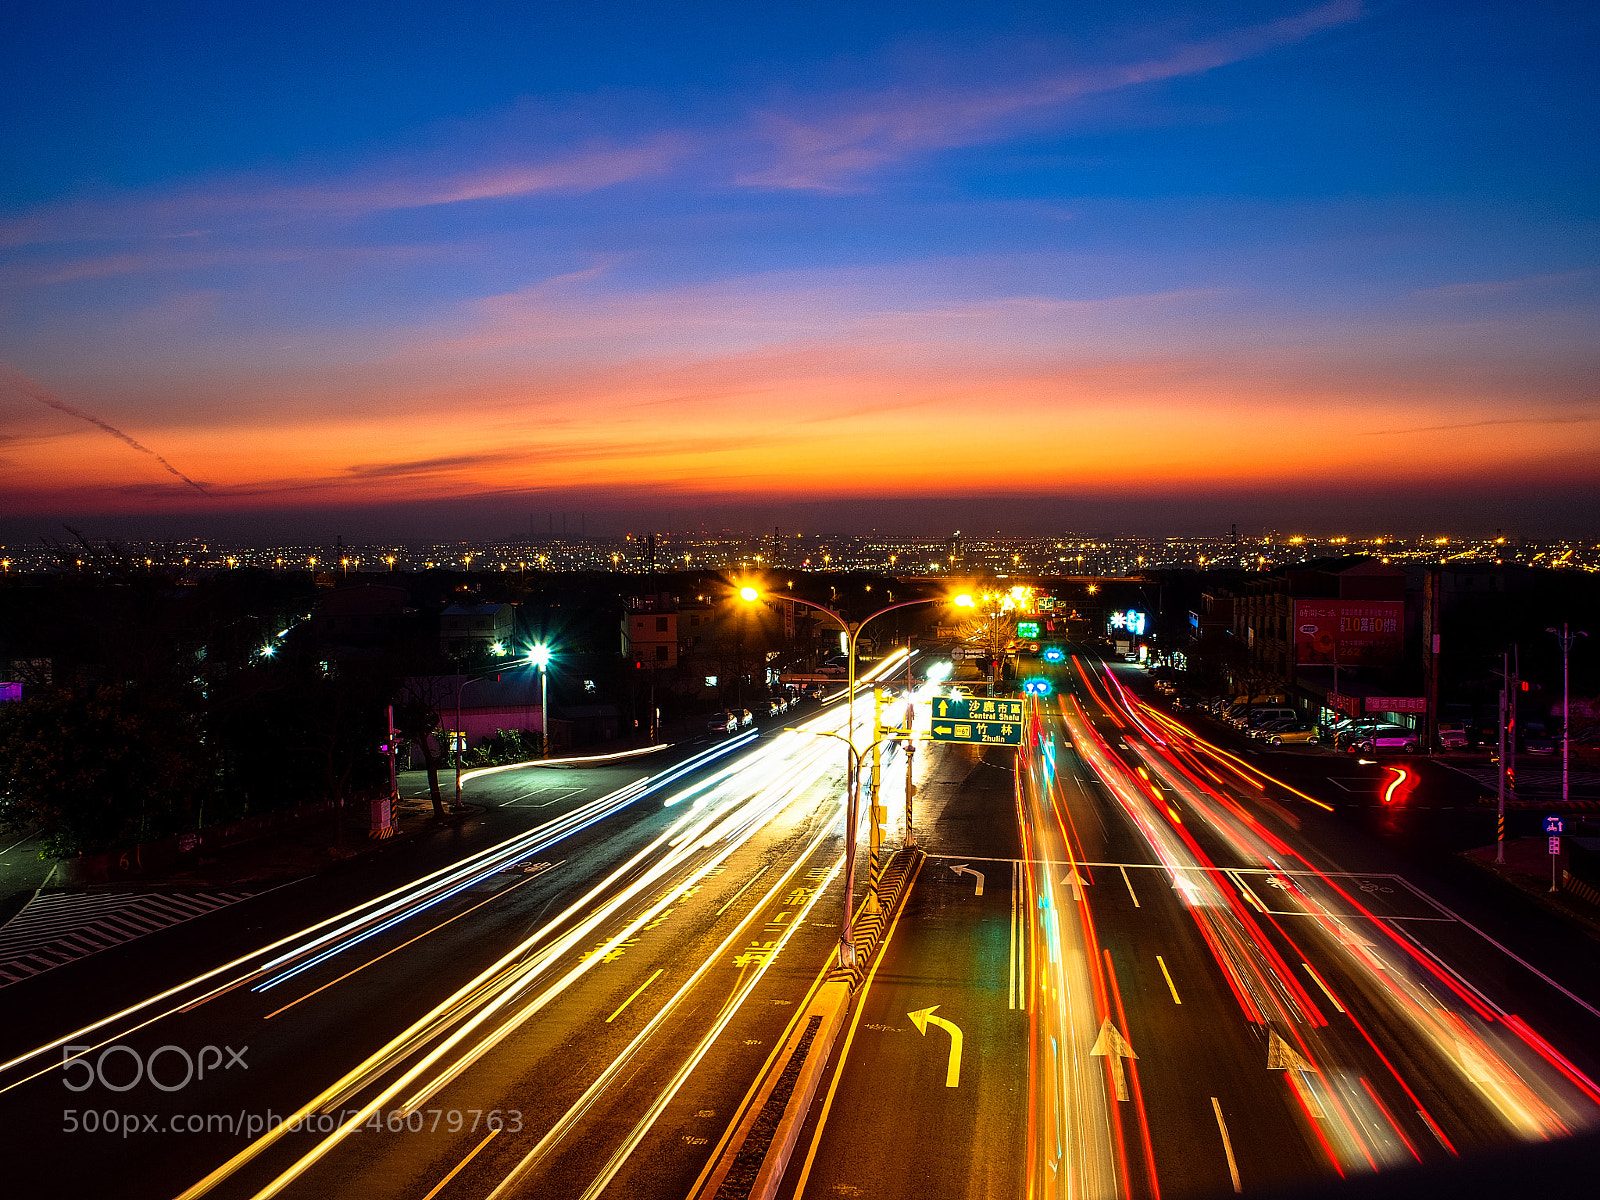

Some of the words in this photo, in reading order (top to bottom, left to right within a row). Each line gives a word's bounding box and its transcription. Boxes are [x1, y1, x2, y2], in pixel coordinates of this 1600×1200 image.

[968, 699, 1021, 714] 沙鹿市區
[969, 712, 996, 720] Central
[998, 713, 1020, 722] Shalu
[975, 722, 1013, 736] 竹林
[981, 734, 1005, 743] Zhulin
